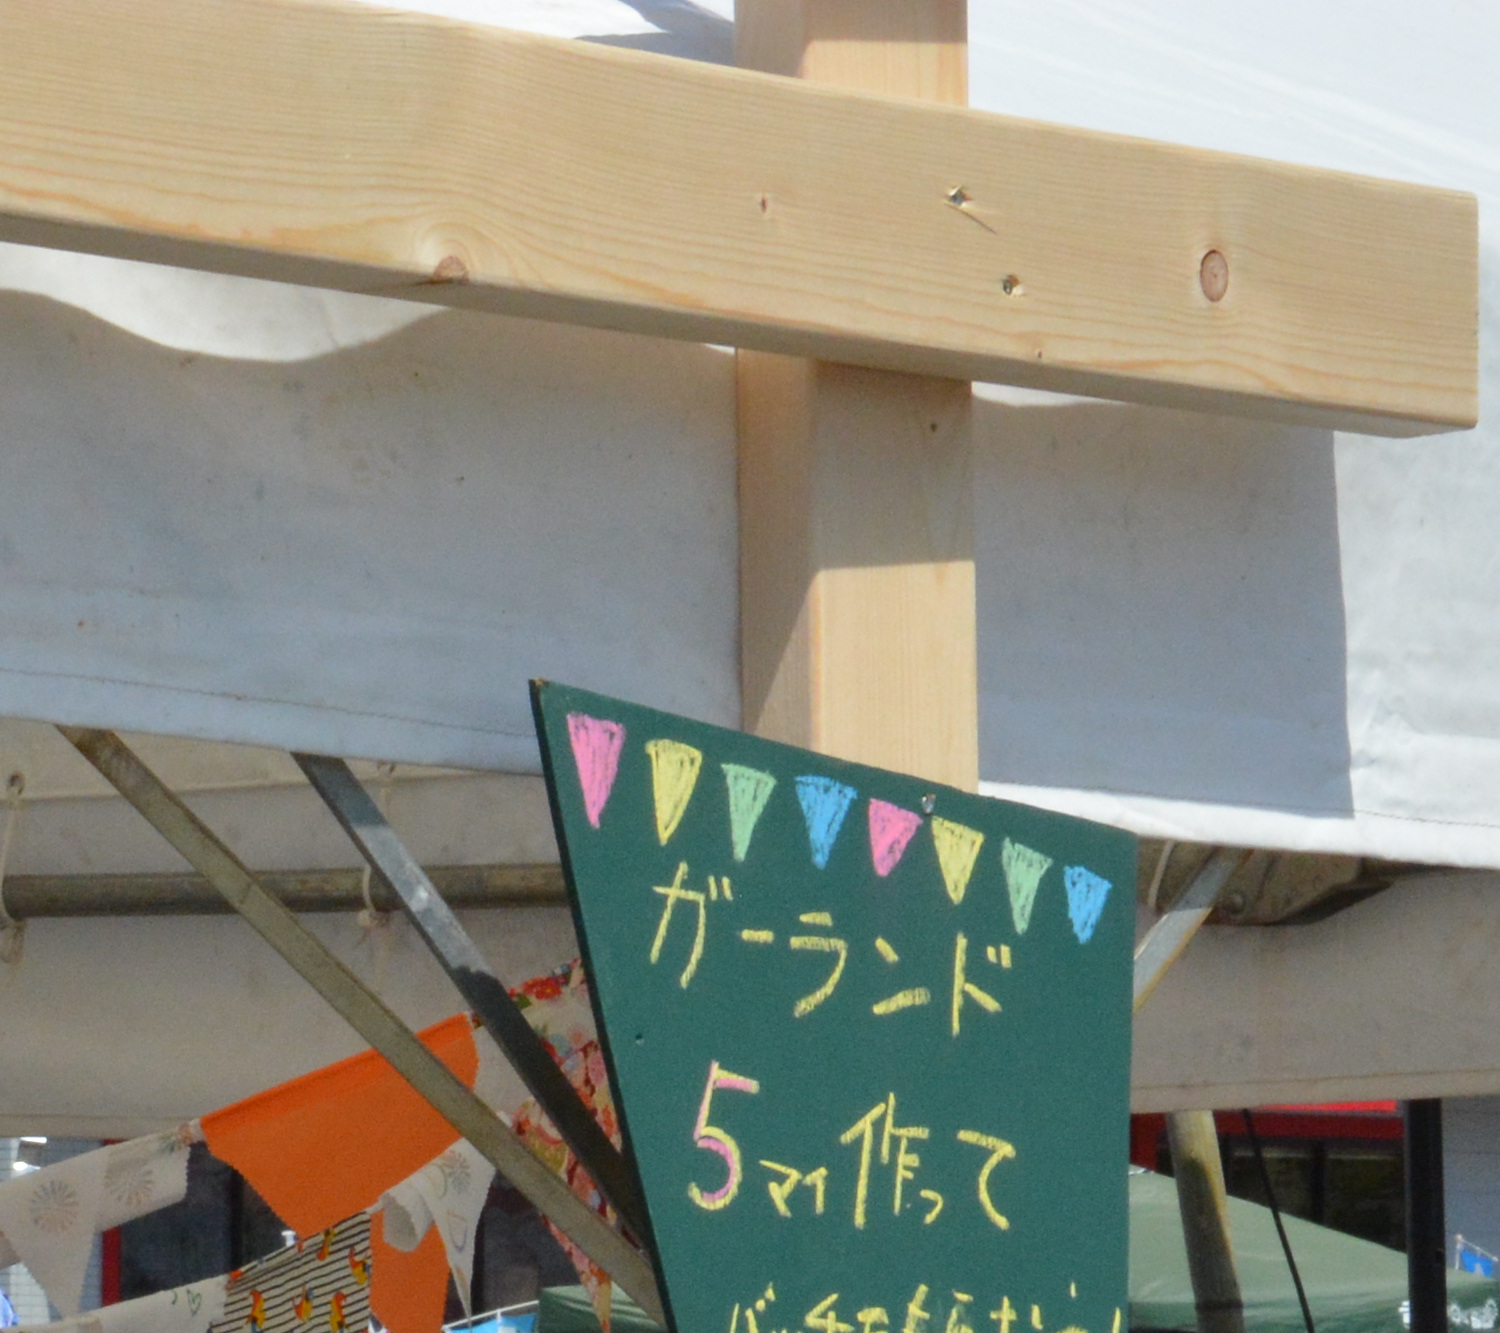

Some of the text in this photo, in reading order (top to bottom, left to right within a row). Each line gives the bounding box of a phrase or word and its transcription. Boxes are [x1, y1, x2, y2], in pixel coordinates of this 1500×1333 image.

[649, 861, 1012, 1038] ガーランド
[688, 1060, 1017, 1230] 5マイ作って
